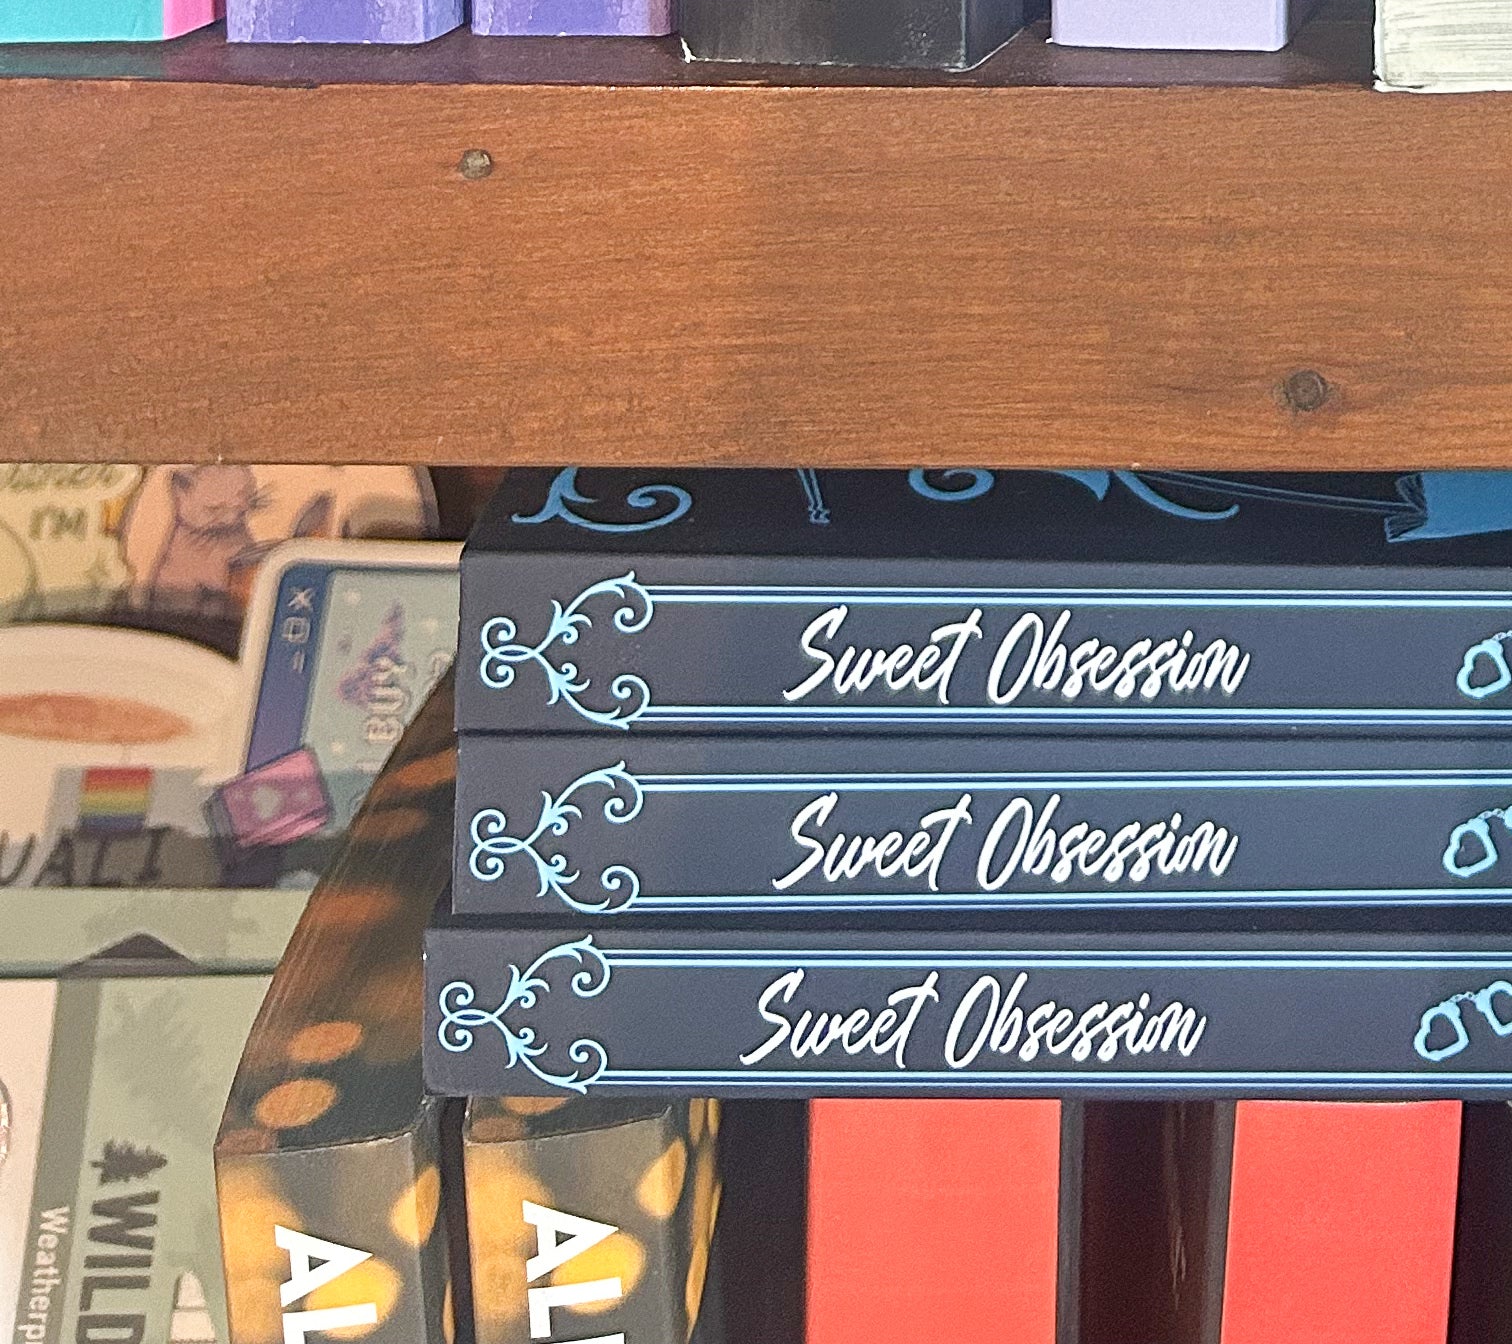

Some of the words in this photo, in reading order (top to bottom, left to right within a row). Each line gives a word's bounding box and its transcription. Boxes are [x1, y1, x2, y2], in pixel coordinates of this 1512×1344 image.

[782, 605, 983, 704] Sweet
[987, 609, 1250, 705] Obsession
[771, 792, 973, 891] Sweet
[976, 794, 1238, 890] Obsession
[740, 969, 939, 1069] Sweet
[944, 972, 1207, 1069] Obsession
[18, 1206, 71, 1344] Weatherp
[75, 1190, 160, 1344] WILD
